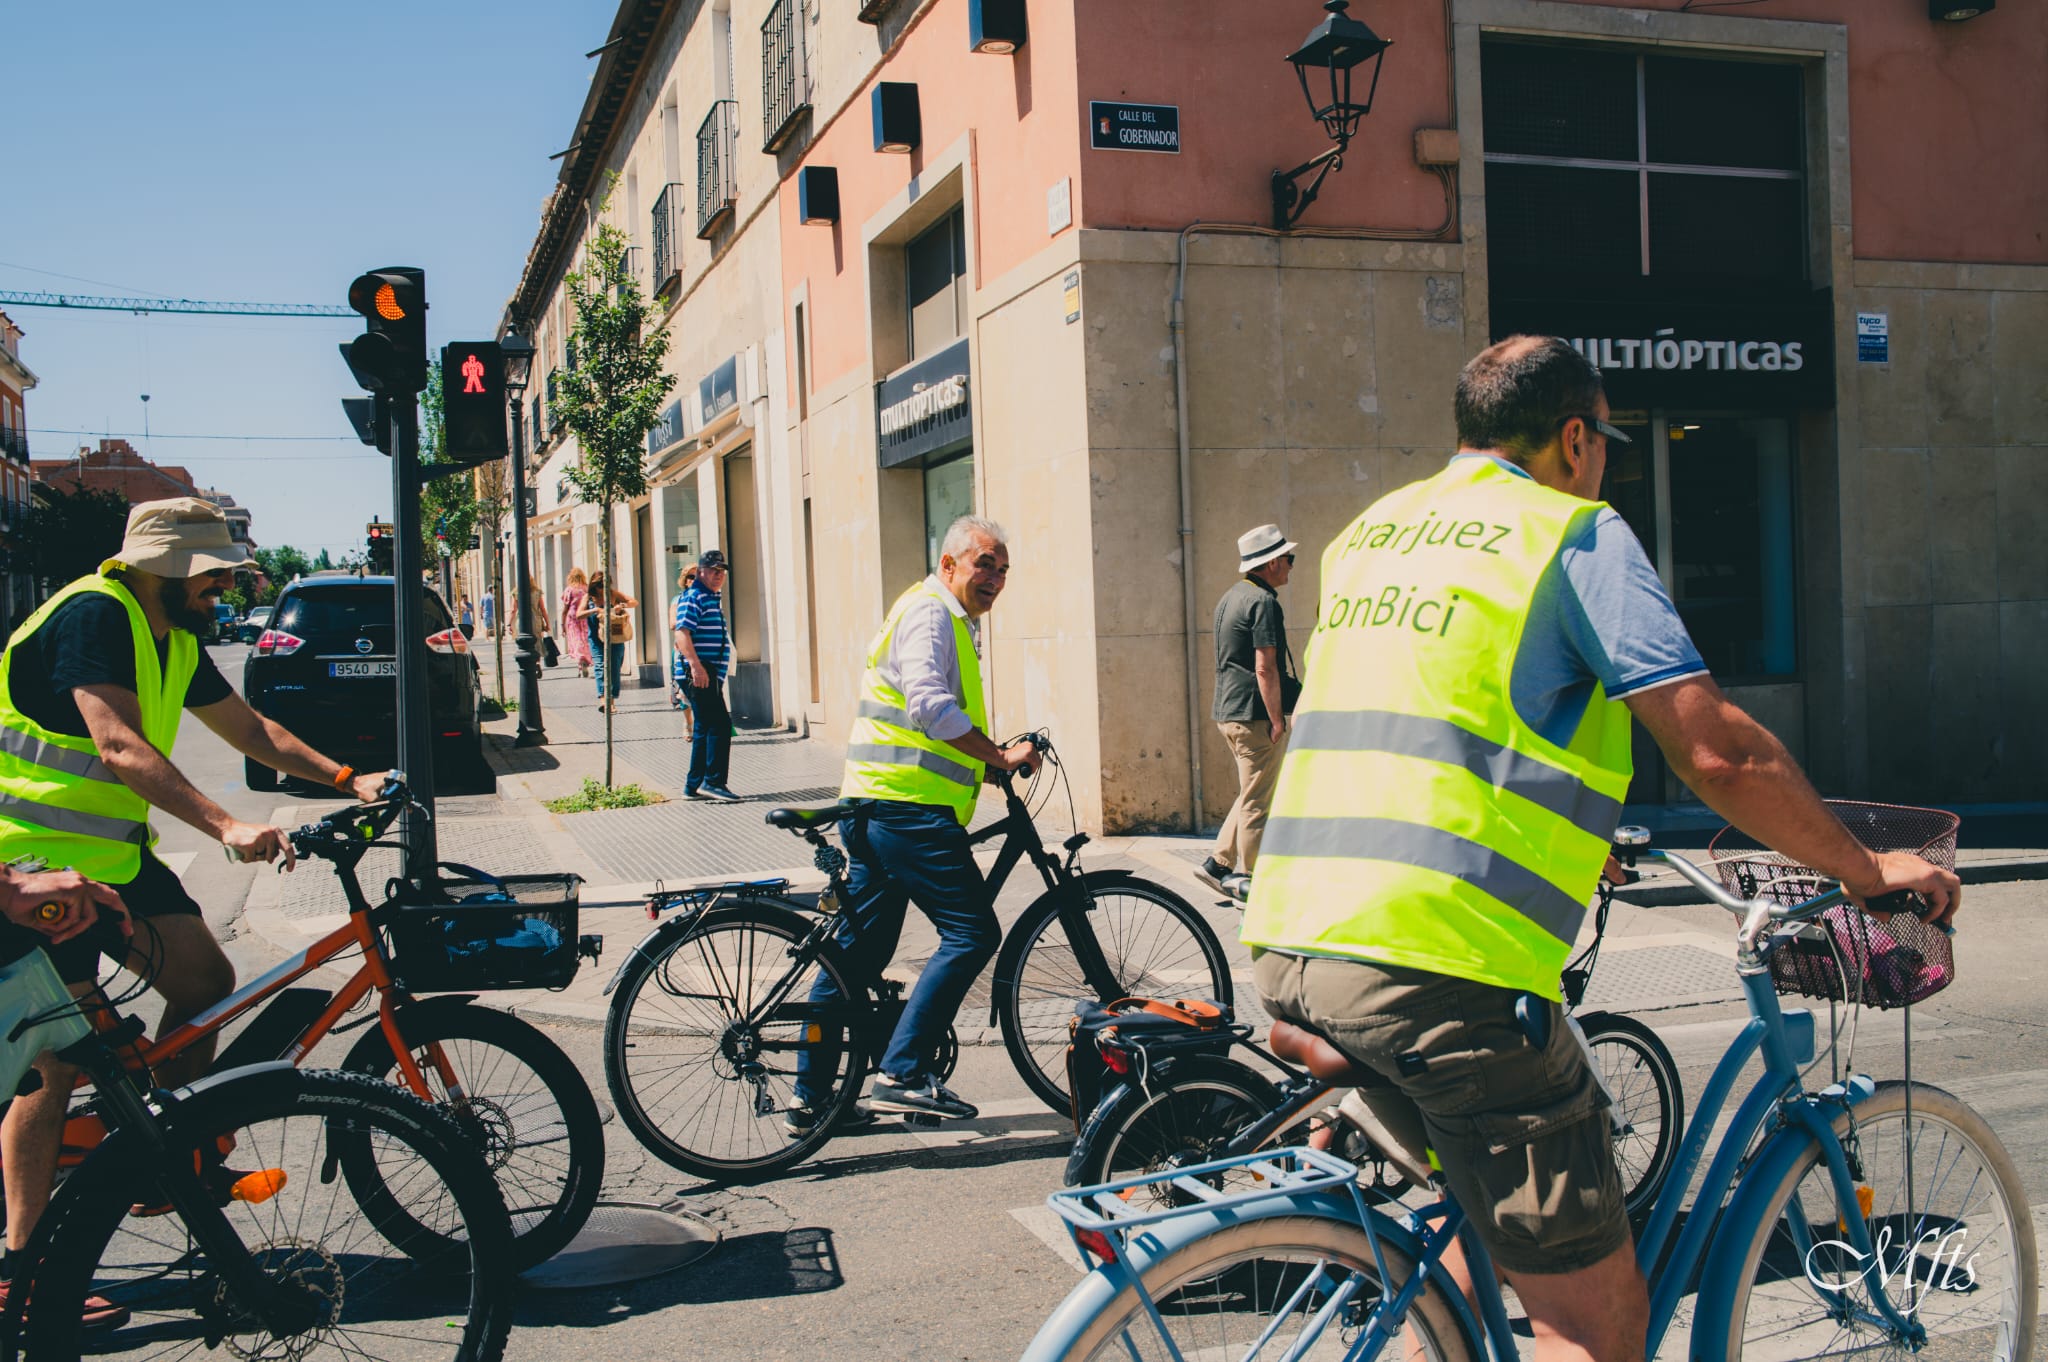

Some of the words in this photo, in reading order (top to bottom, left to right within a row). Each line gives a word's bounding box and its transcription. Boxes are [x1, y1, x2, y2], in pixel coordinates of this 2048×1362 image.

[1118, 110, 1140, 121] CALLE
[1142, 112, 1156, 122] DEL
[1120, 128, 1178, 146] GOBERNADOR
[1318, 586, 1460, 637] onBici
[337, 663, 369, 675] 9540
[375, 663, 397, 675] JSN
